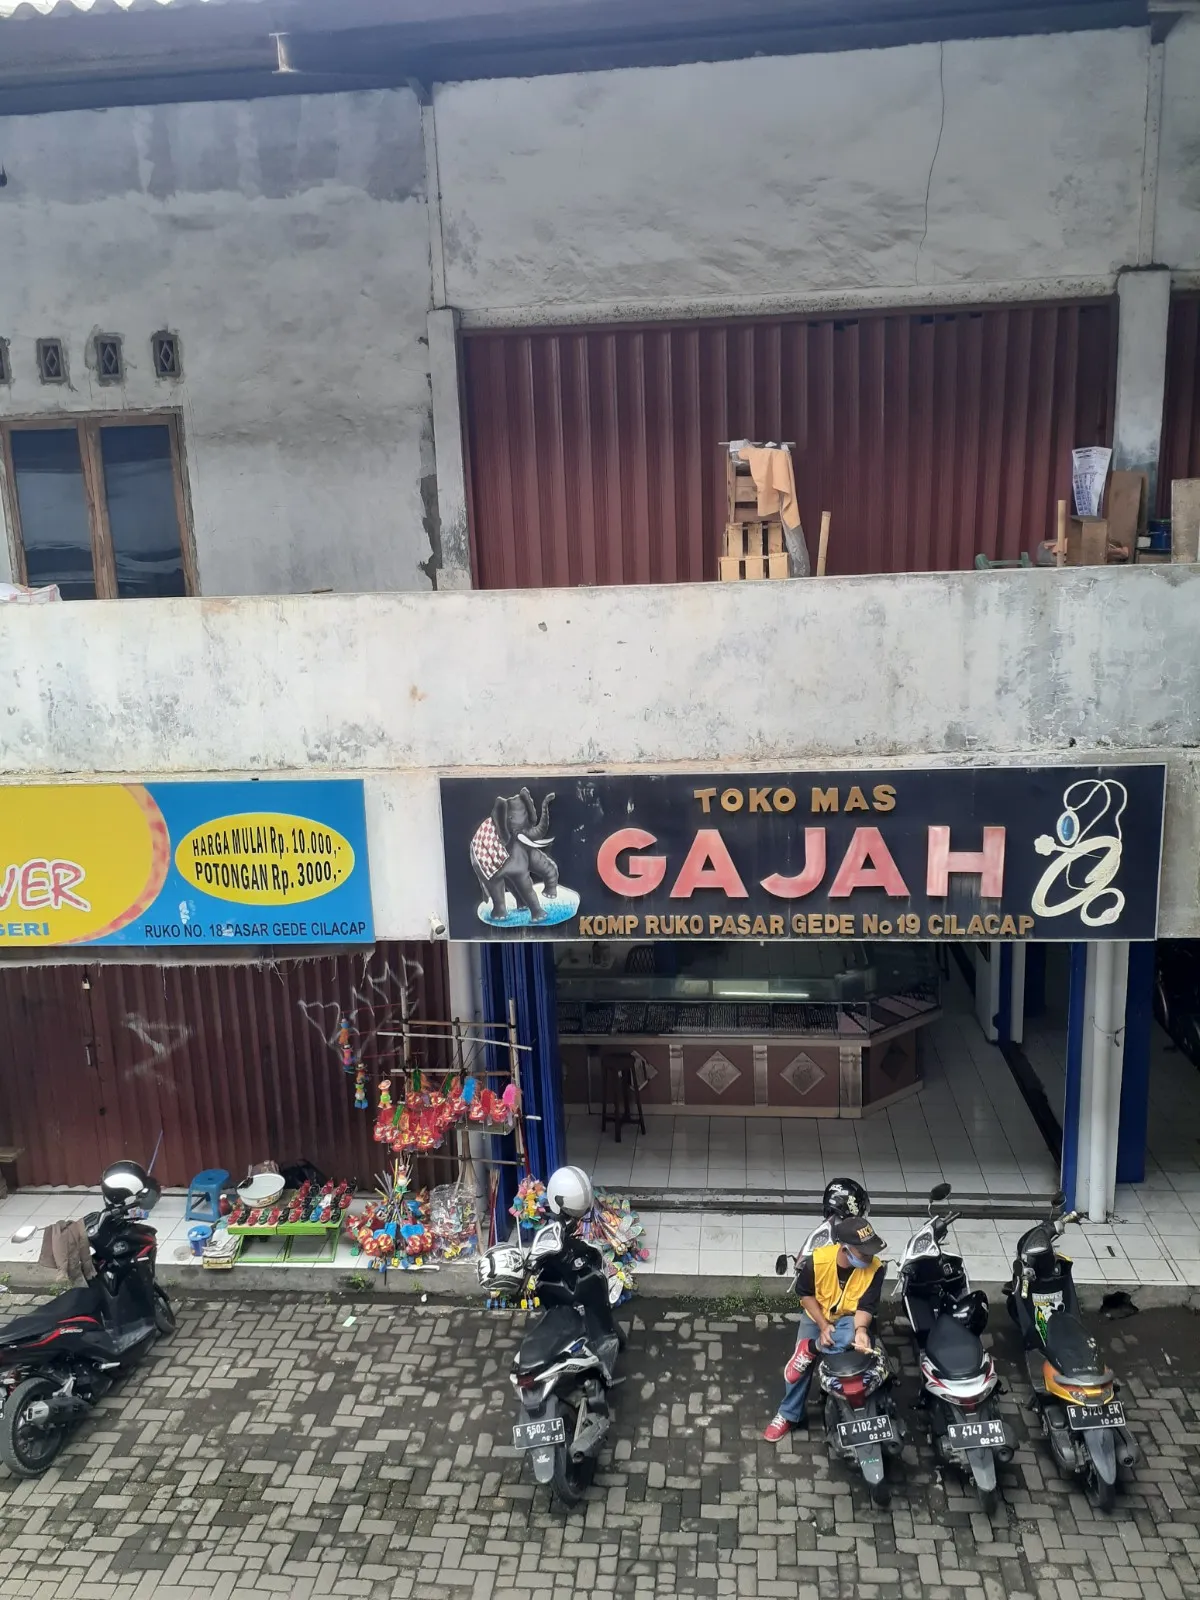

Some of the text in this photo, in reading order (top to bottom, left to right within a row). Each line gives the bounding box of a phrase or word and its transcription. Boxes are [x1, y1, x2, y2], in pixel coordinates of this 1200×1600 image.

[693, 784, 897, 813] TOKO MAS
[192, 830, 230, 856] HARGA
[231, 826, 268, 854] MULAI
[270, 826, 289, 859] Rp.
[597, 825, 1006, 898] GAJAH
[195, 860, 342, 895] POTONGAN Rp. 3000,-
[145, 924, 181, 938] RUKO
[184, 924, 206, 937] NO.
[209, 924, 223, 937] 18
[272, 922, 307, 936] GEDE
[311, 921, 366, 936] CILACAP
[579, 915, 639, 935] KOMP
[644, 914, 704, 935] RUKO
[709, 914, 784, 935] PASAR
[792, 913, 855, 934] GEDE
[928, 914, 1034, 935] CILACAP
[1070, 1408, 1076, 1417] R
[1108, 1403, 1120, 1414] EK
[515, 1427, 521, 1437] R
[551, 1420, 561, 1431] LF
[840, 1417, 887, 1436] R 4102 SP
[949, 1427, 956, 1437] R
[988, 1422, 1001, 1433] PK
